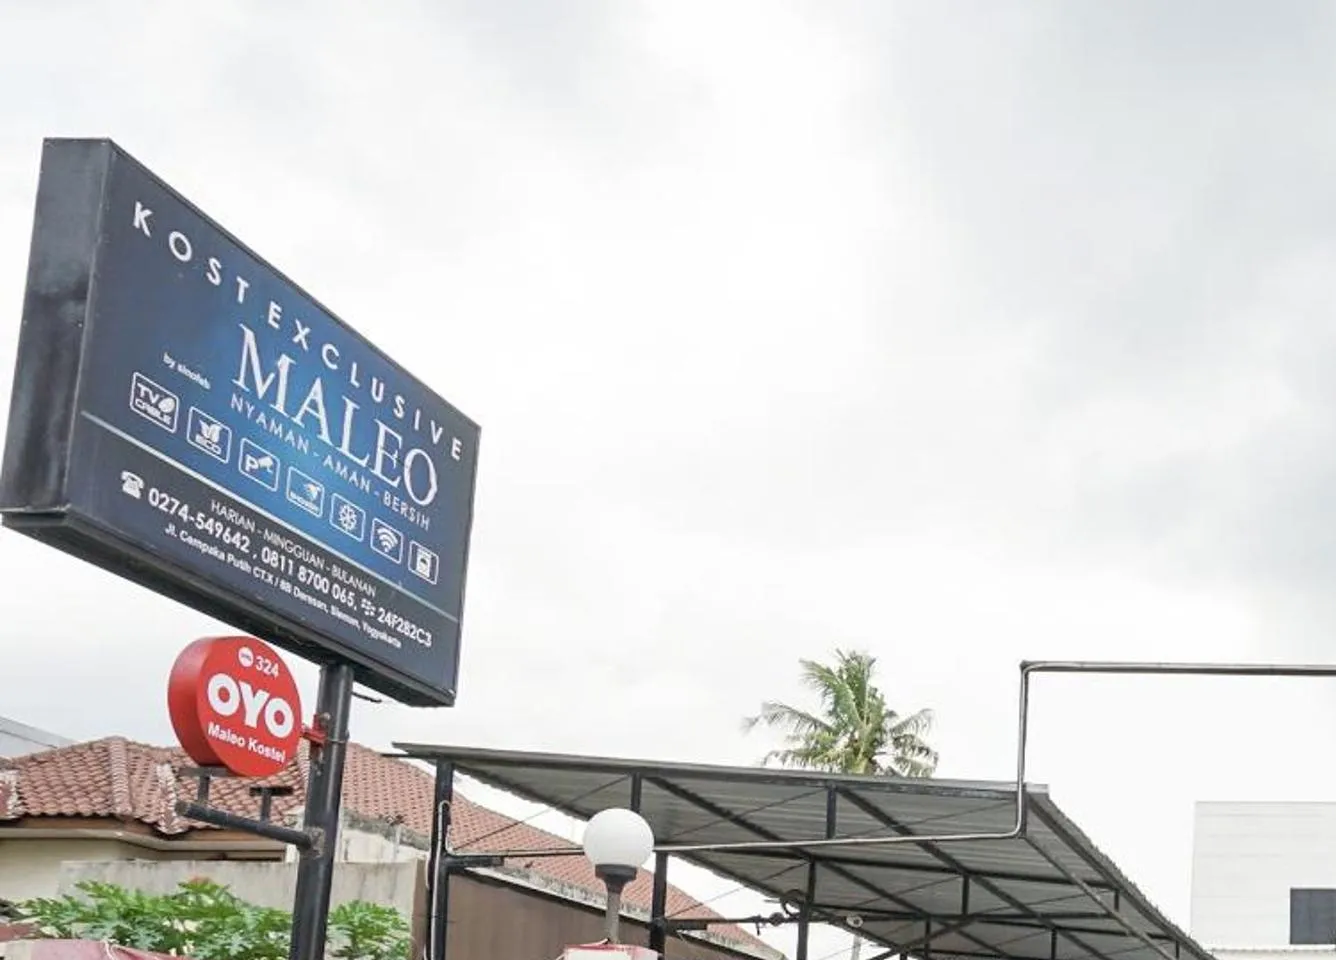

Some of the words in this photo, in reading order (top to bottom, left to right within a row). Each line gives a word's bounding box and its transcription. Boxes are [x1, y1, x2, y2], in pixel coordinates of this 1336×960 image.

[132, 200, 250, 304] KOST
[267, 300, 463, 462] EXCLUSIVE
[135, 398, 172, 425] CABLE
[137, 382, 160, 404] TV
[232, 322, 438, 506] MALEO
[195, 434, 222, 455] ECO
[230, 393, 309, 454] NYAMAN
[323, 454, 371, 494] AMAN
[383, 490, 430, 532] BERSIH
[244, 453, 259, 473] P
[148, 487, 250, 553] 0274-549642
[261, 546, 294, 576] 0811
[298, 565, 329, 594] 8700
[211, 500, 256, 533] HARIAN
[263, 528, 326, 571] MINGGUAN
[331, 564, 377, 598] BULANAN
[255, 655, 280, 679] 324
[207, 672, 295, 738] OYO
[208, 721, 246, 748] Maleo
[247, 736, 286, 764] Kostel
